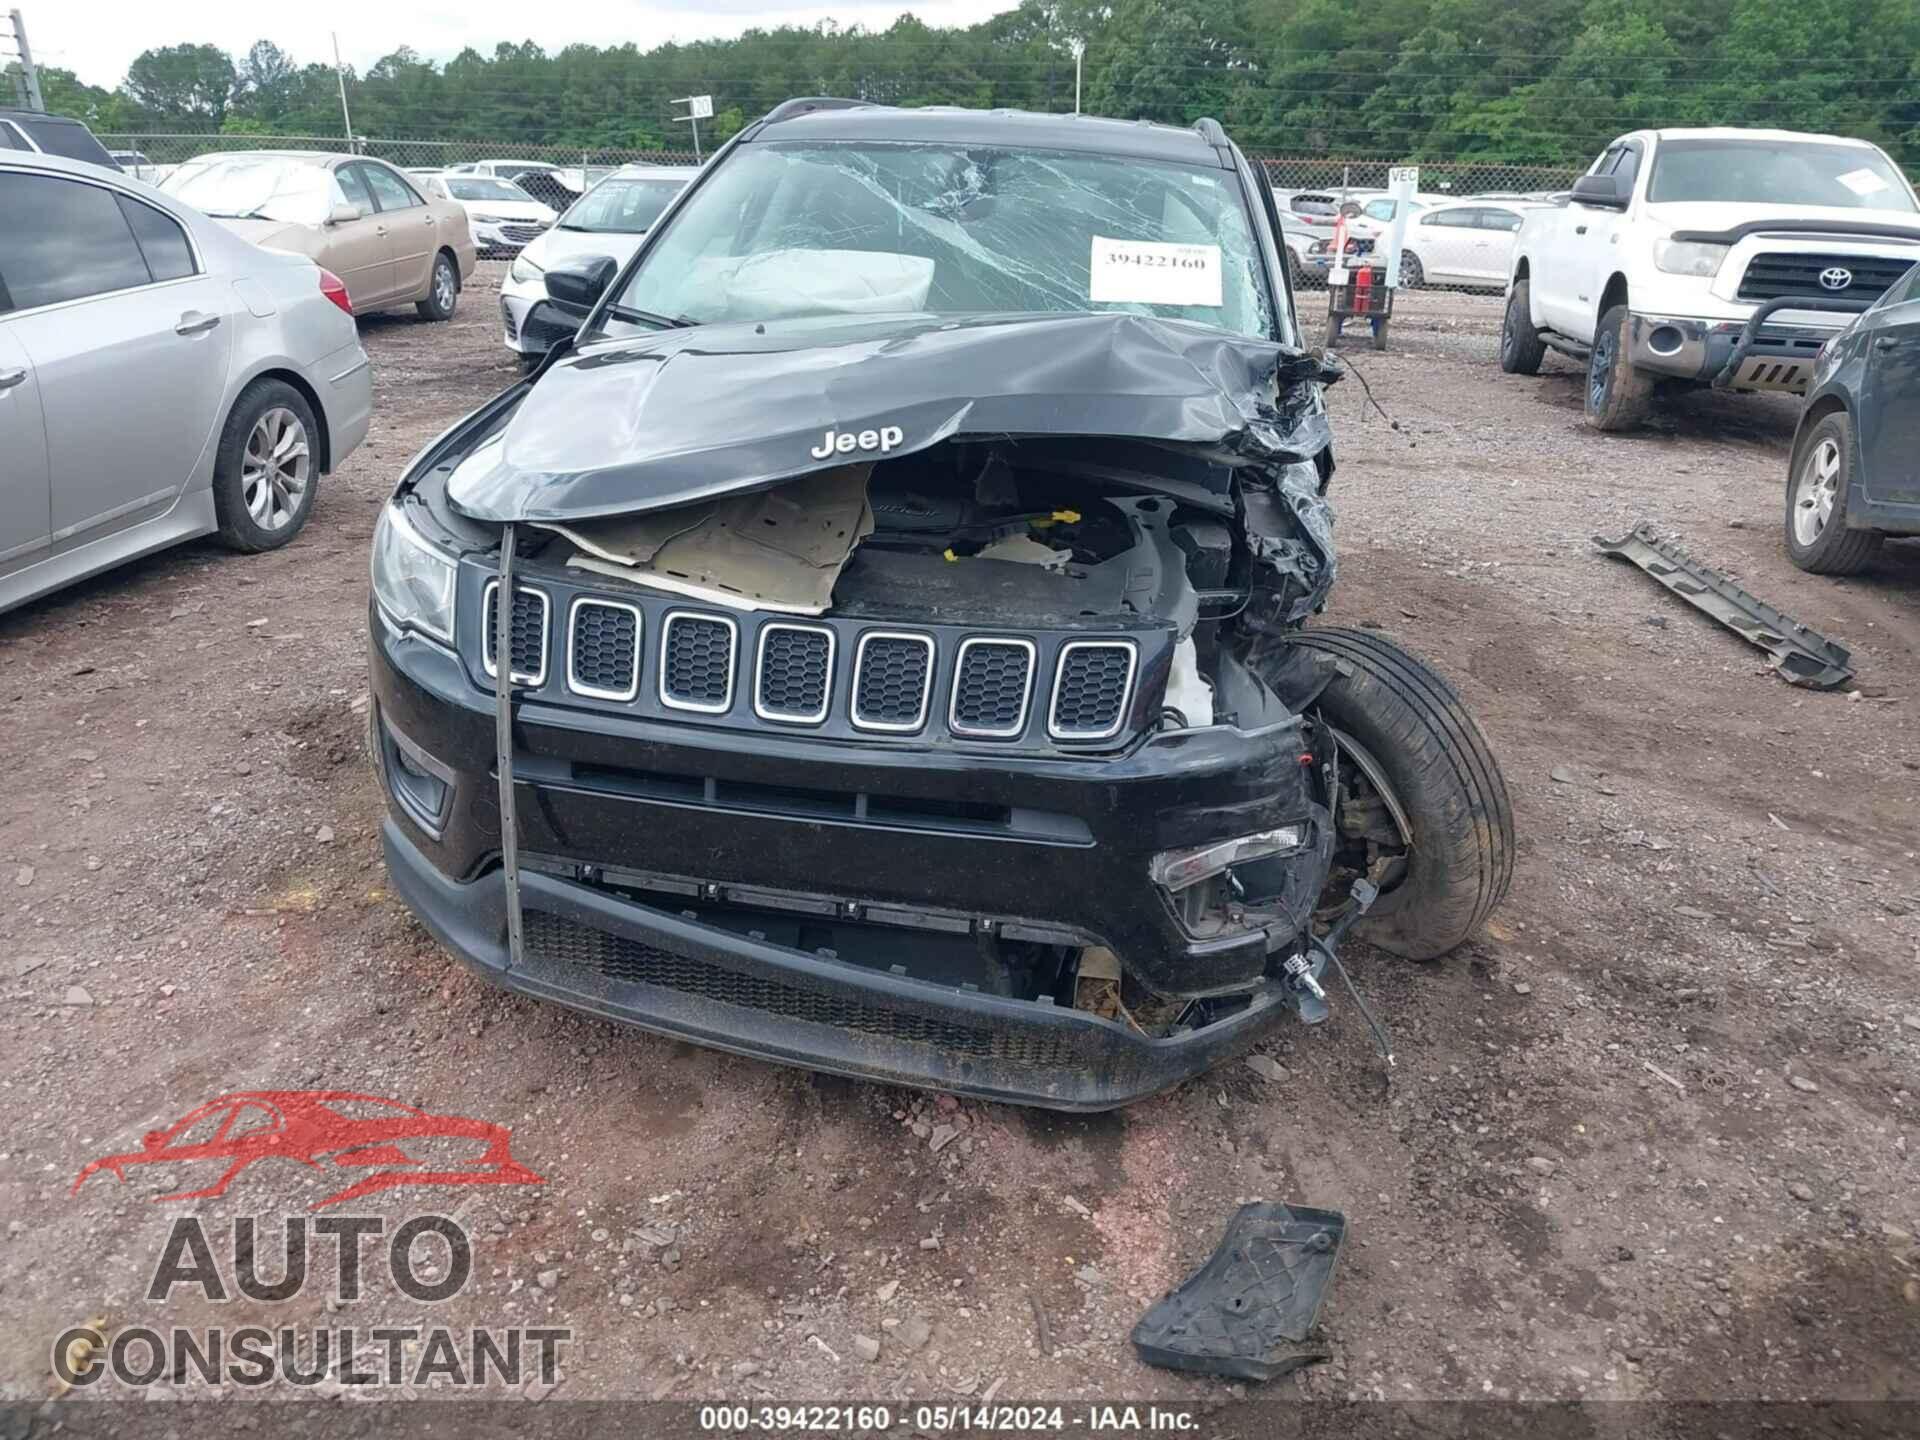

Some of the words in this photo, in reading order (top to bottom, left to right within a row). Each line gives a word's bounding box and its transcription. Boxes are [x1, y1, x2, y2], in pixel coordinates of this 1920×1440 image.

[1391, 168, 1417, 182] VEC
[1105, 252, 1206, 269] 39422160
[811, 426, 903, 459] Jeep
